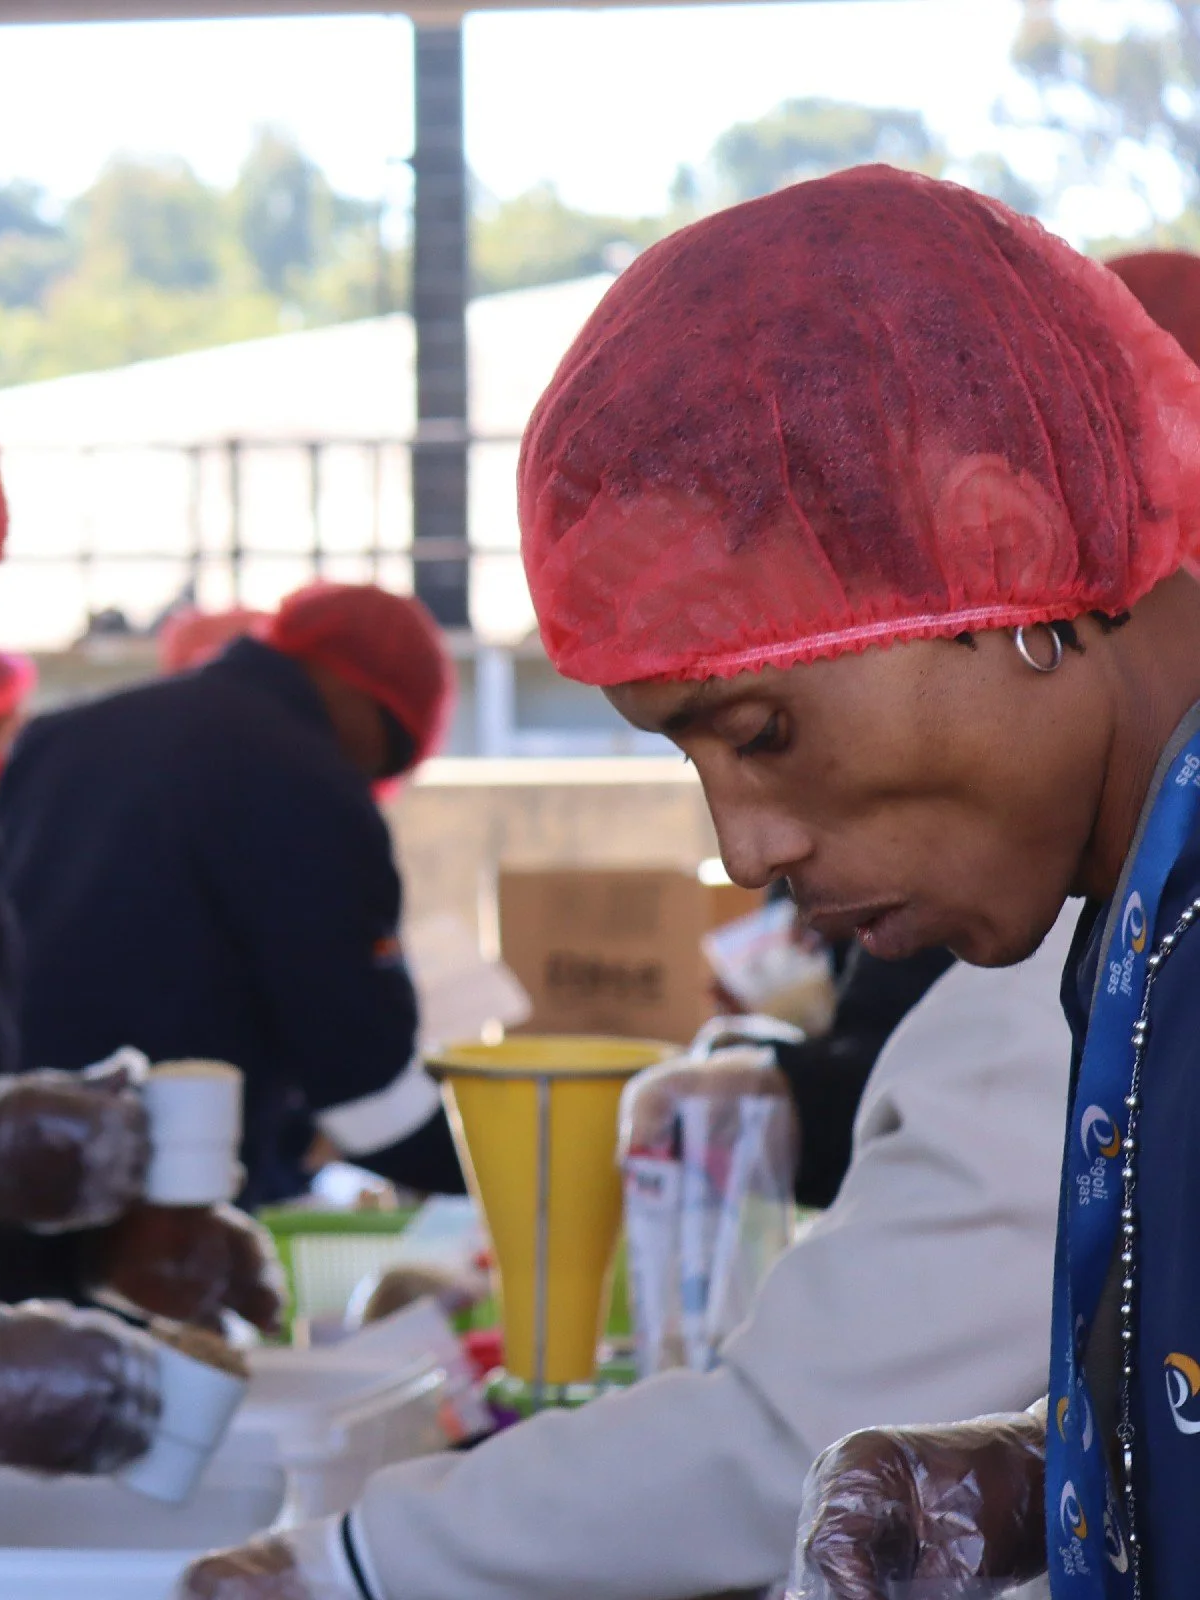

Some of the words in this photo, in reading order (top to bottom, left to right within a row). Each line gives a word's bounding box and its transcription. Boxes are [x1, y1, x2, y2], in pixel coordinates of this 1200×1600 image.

[1175, 753, 1199, 786] gas
[1107, 961, 1122, 995] gas
[1120, 950, 1135, 996] egoli
[1076, 1174, 1090, 1205] gas
[1090, 1157, 1108, 1199] egoli
